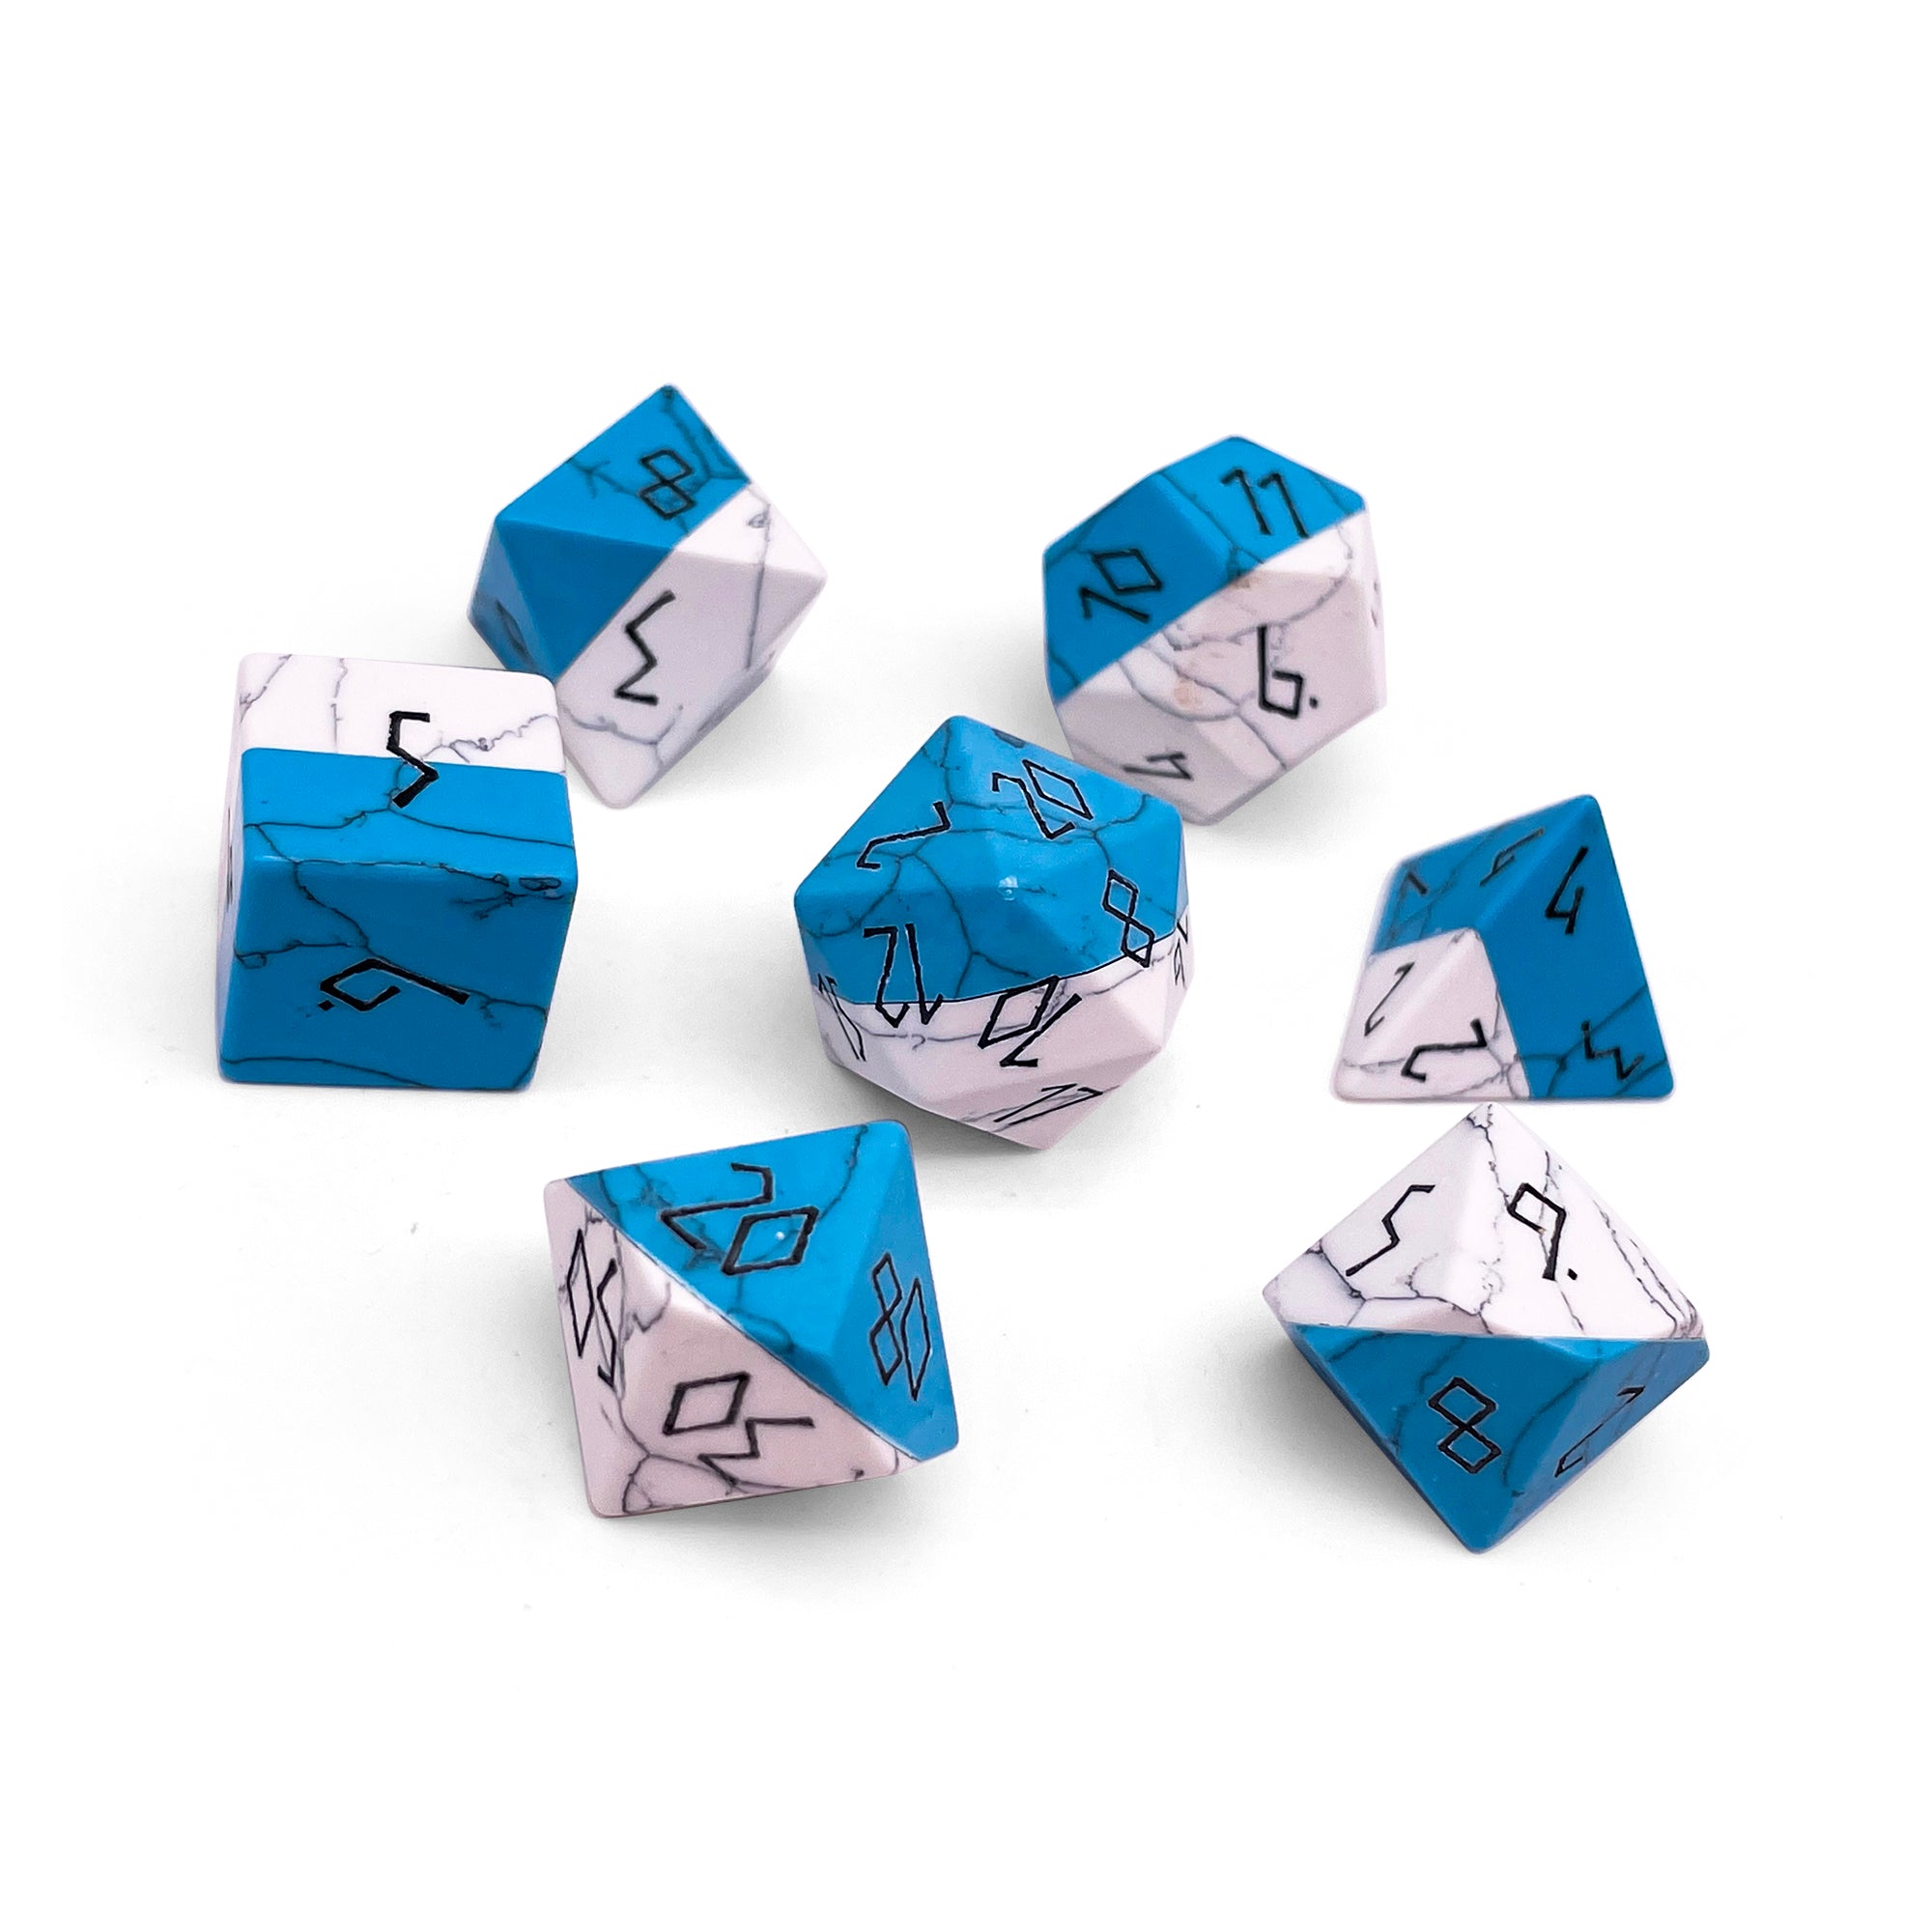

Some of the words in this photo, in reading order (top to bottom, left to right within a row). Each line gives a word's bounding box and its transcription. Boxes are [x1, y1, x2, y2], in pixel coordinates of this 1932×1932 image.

[639, 448, 697, 521] 8
[1220, 468, 1310, 540] 11
[1077, 548, 1162, 626] 10
[386, 710, 440, 809] 5
[991, 758, 1103, 840] 20
[1101, 867, 1156, 969] 8
[1544, 846, 1589, 935] 4
[660, 1161, 820, 1277] 20
[869, 1251, 932, 1403] 80
[1428, 1376, 1502, 1475] 8
